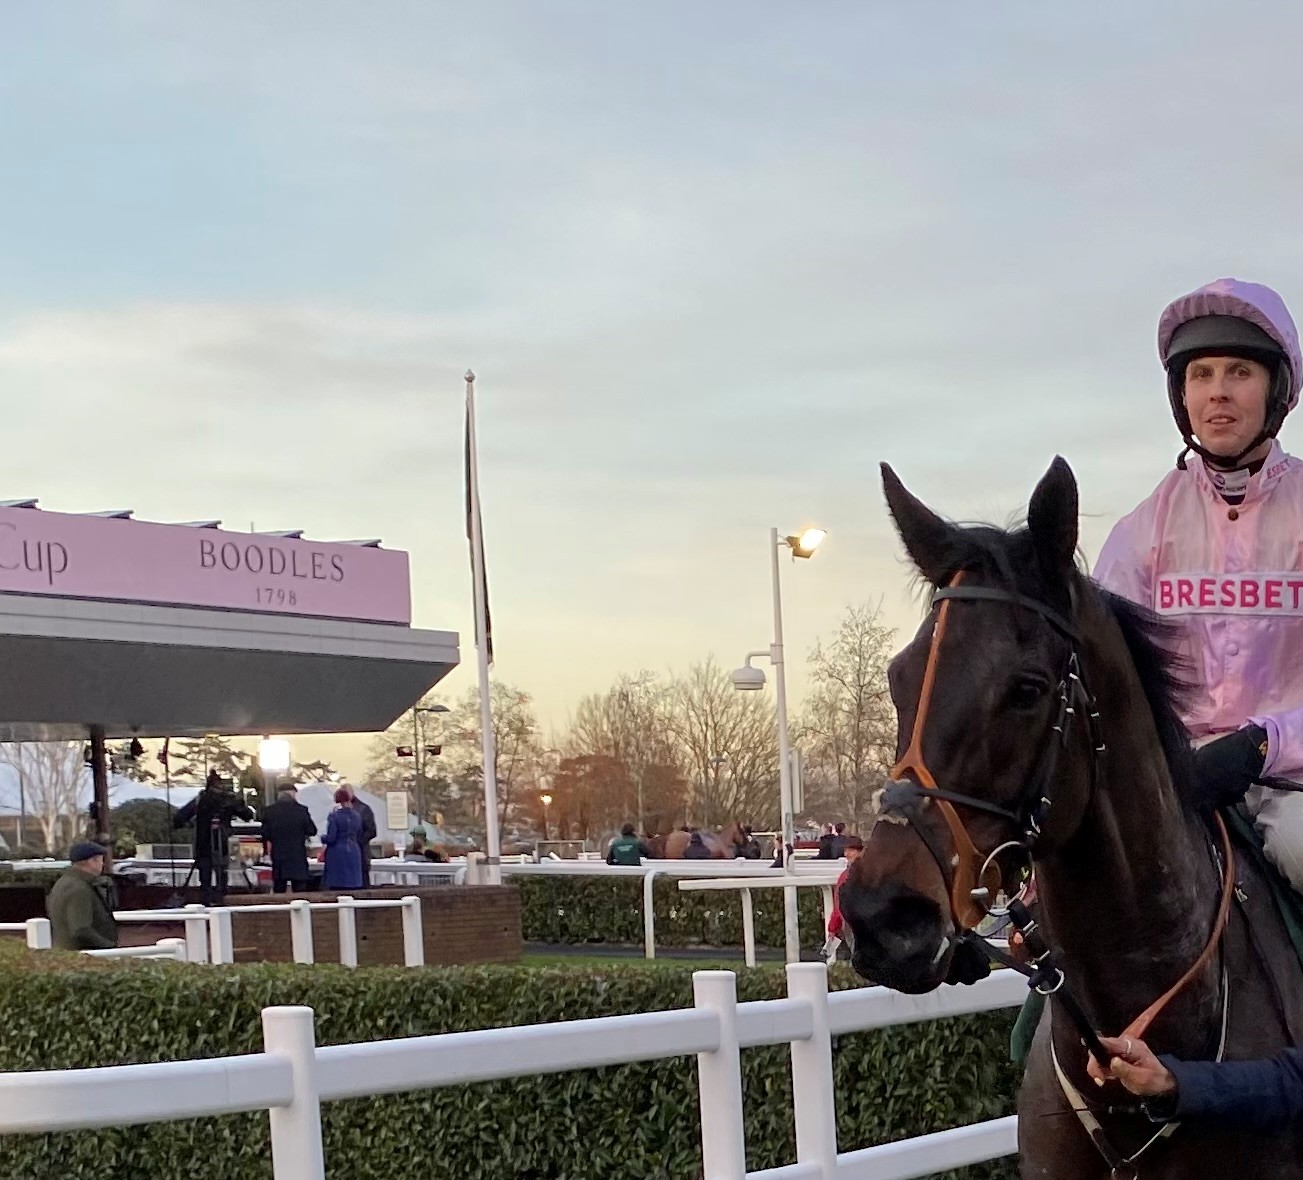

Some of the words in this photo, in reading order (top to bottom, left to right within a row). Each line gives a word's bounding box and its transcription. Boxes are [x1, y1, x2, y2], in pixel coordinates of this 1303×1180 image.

[0, 522, 68, 586] Cup
[200, 539, 344, 582] BOODLES
[256, 585, 297, 606] 1798
